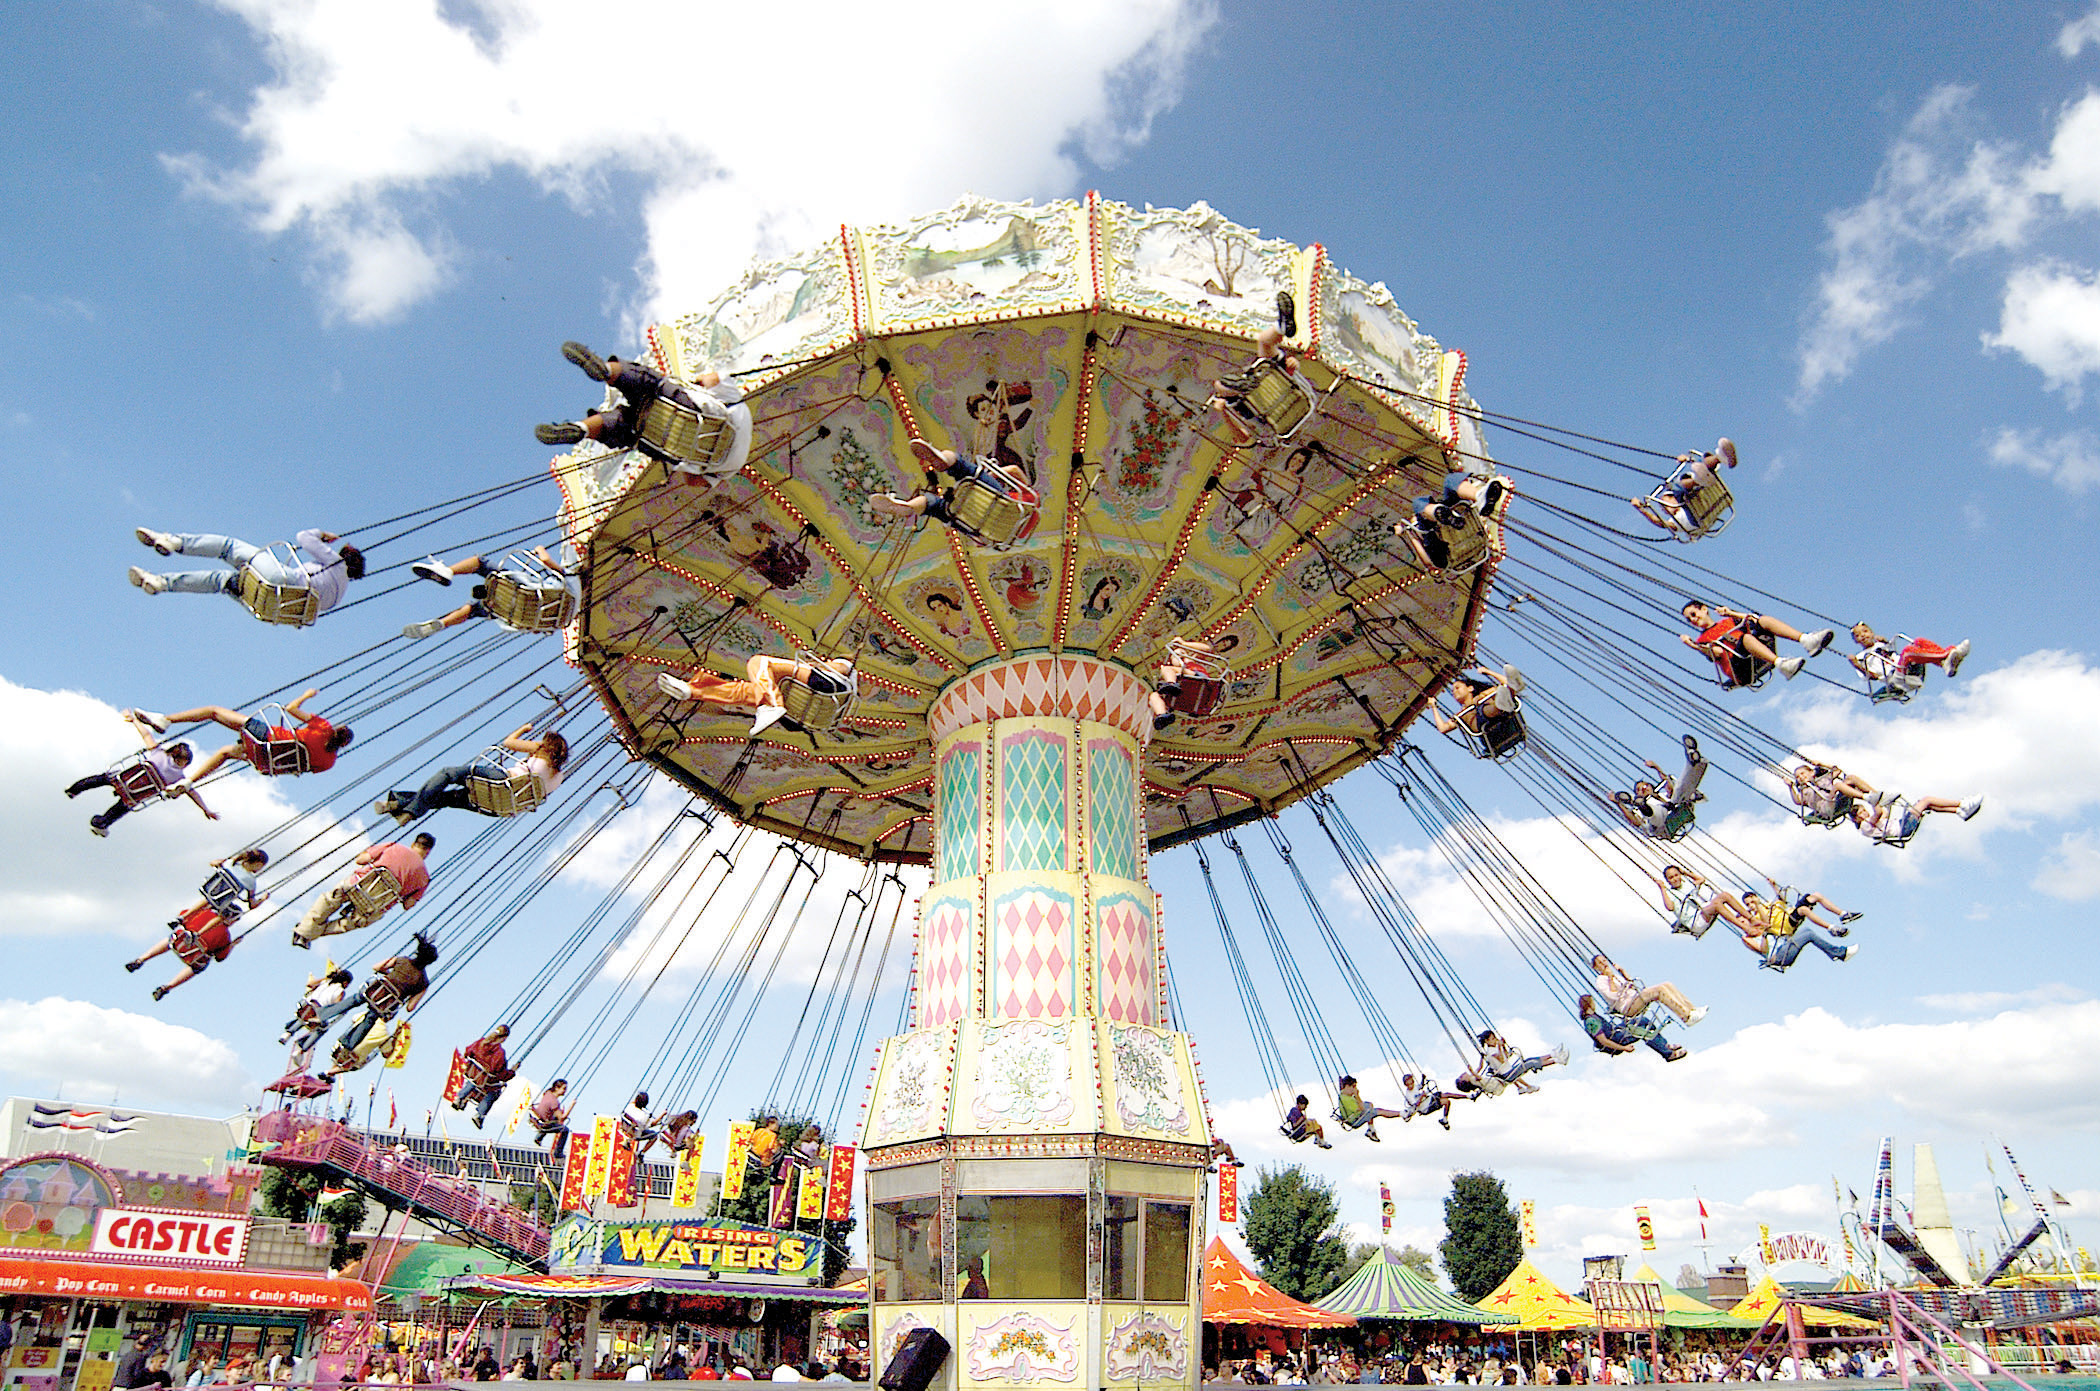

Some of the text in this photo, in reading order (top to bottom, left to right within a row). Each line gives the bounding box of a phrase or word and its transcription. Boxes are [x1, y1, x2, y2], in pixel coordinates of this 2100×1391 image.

[108, 1217, 235, 1256] CASTLE
[618, 1226, 807, 1271] WATERS
[684, 1227, 770, 1242] RISING
[55, 1277, 83, 1291] Pop
[86, 1280, 119, 1292] Corn
[144, 1283, 190, 1296] Carmel
[195, 1286, 226, 1298] Corn
[249, 1289, 286, 1303] Candy
[288, 1290, 328, 1304] Apples
[345, 1296, 367, 1307] Cold
